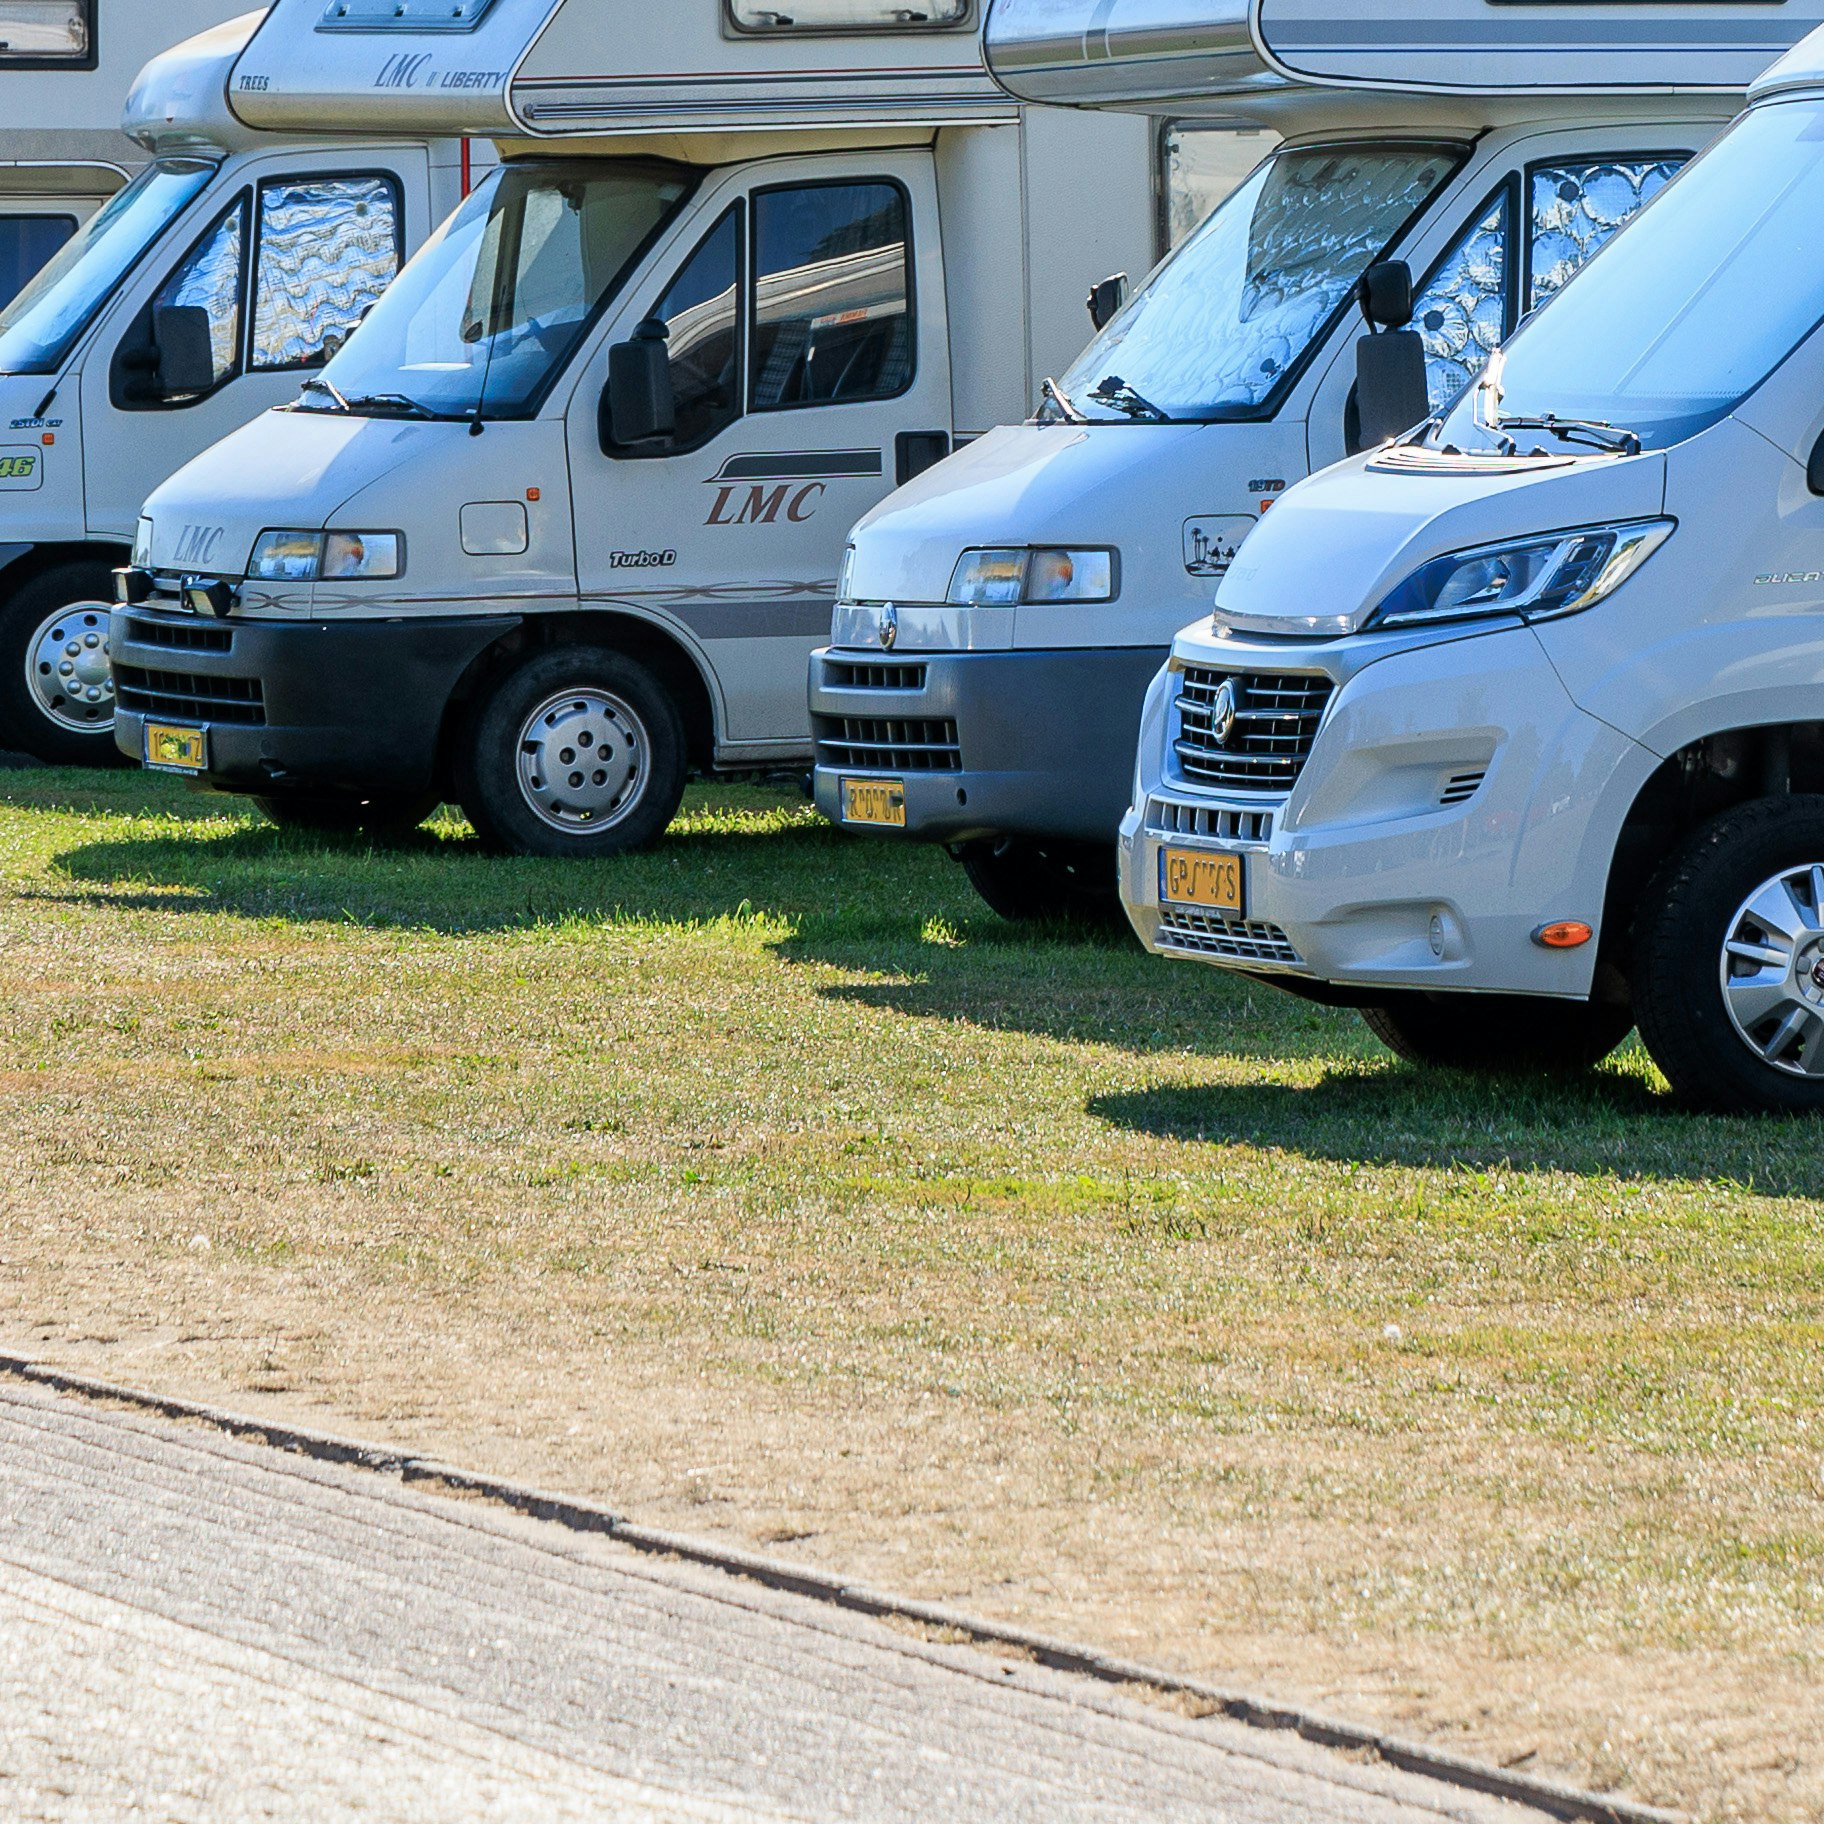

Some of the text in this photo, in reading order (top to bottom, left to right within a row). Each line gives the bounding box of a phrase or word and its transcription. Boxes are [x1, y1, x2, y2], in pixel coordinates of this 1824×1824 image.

[373, 53, 508, 89] LMC LIBERTY
[702, 482, 827, 525] LMC
[173, 524, 224, 564] LMC
